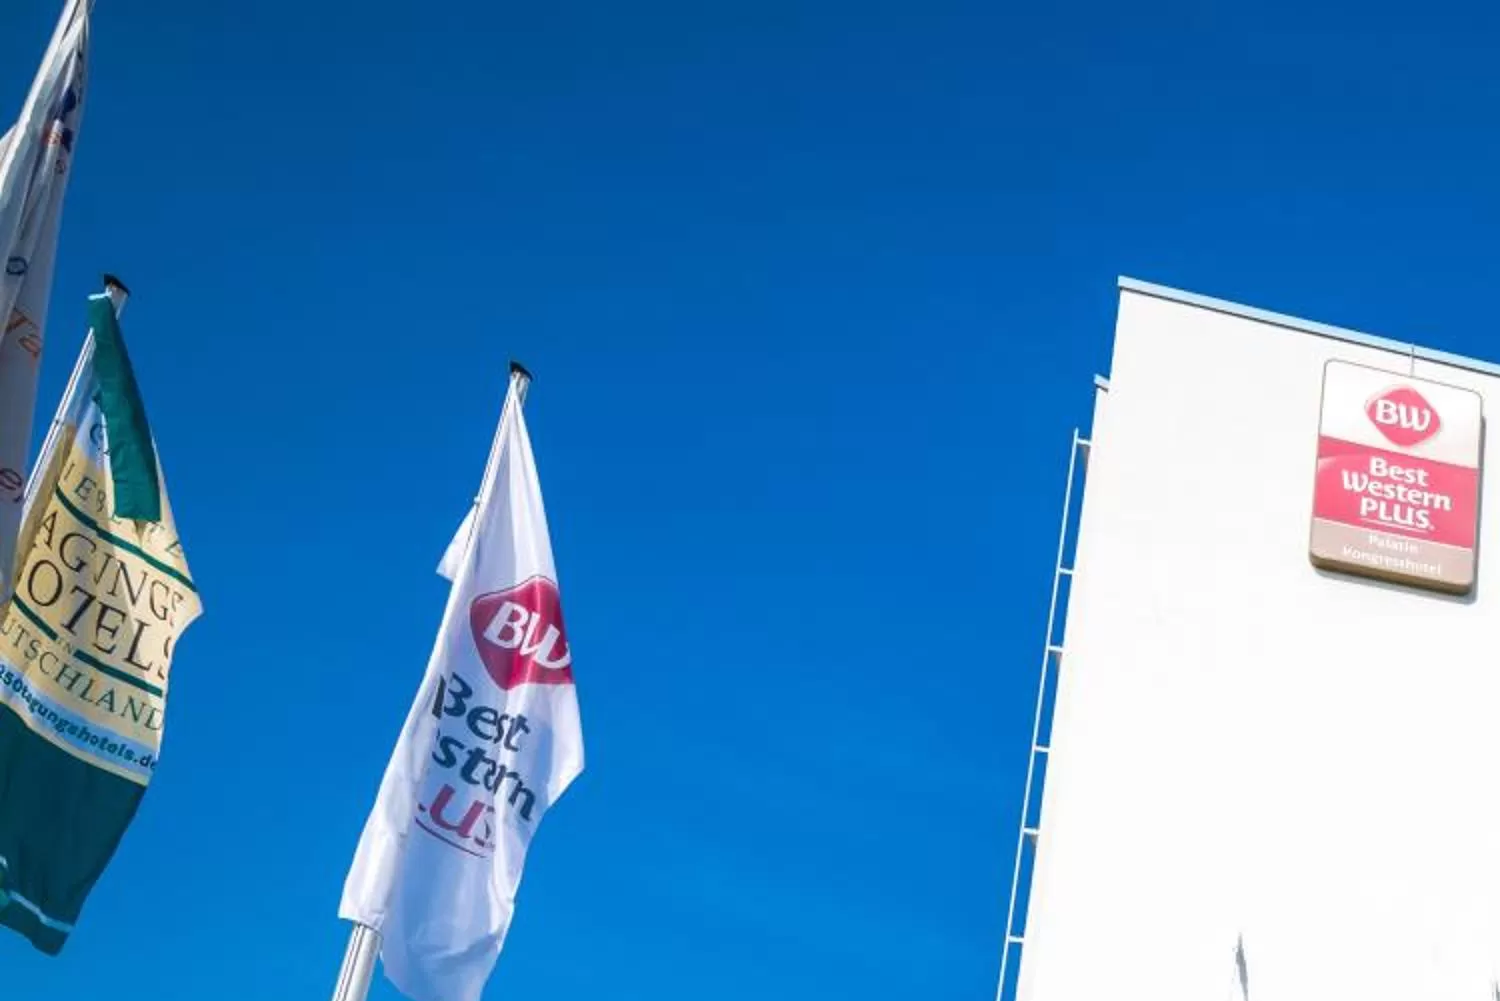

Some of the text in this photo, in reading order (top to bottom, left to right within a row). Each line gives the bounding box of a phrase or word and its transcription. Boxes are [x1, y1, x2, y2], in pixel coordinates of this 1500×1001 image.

[1375, 400, 1431, 432] BW
[1370, 456, 1429, 487] Best
[1341, 470, 1452, 511] Western
[1360, 498, 1431, 529] PLUS
[432, 672, 530, 752] Best
